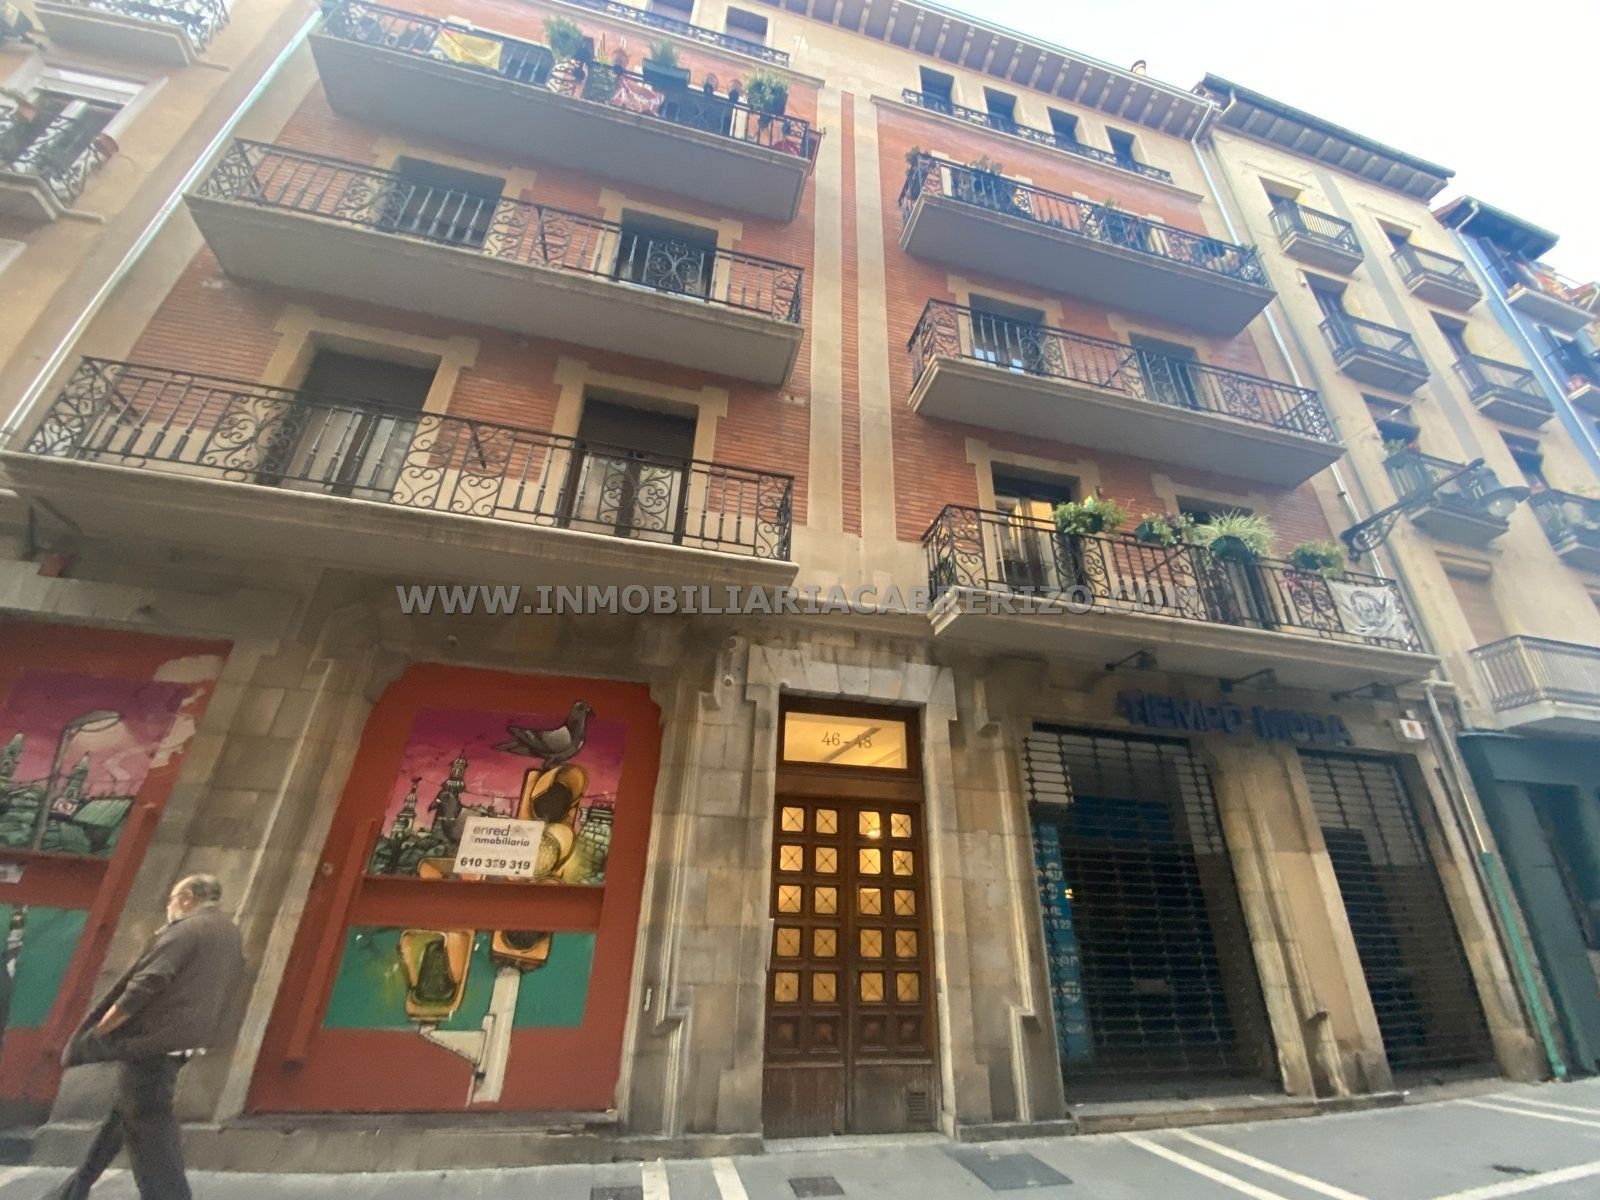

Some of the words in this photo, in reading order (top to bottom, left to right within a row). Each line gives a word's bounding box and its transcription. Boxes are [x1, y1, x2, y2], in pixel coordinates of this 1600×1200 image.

[821, 731, 841, 746] 46
[855, 734, 872, 749] 48
[472, 824, 511, 837] enred
[460, 857, 482, 867] 610
[509, 859, 531, 870] 319
